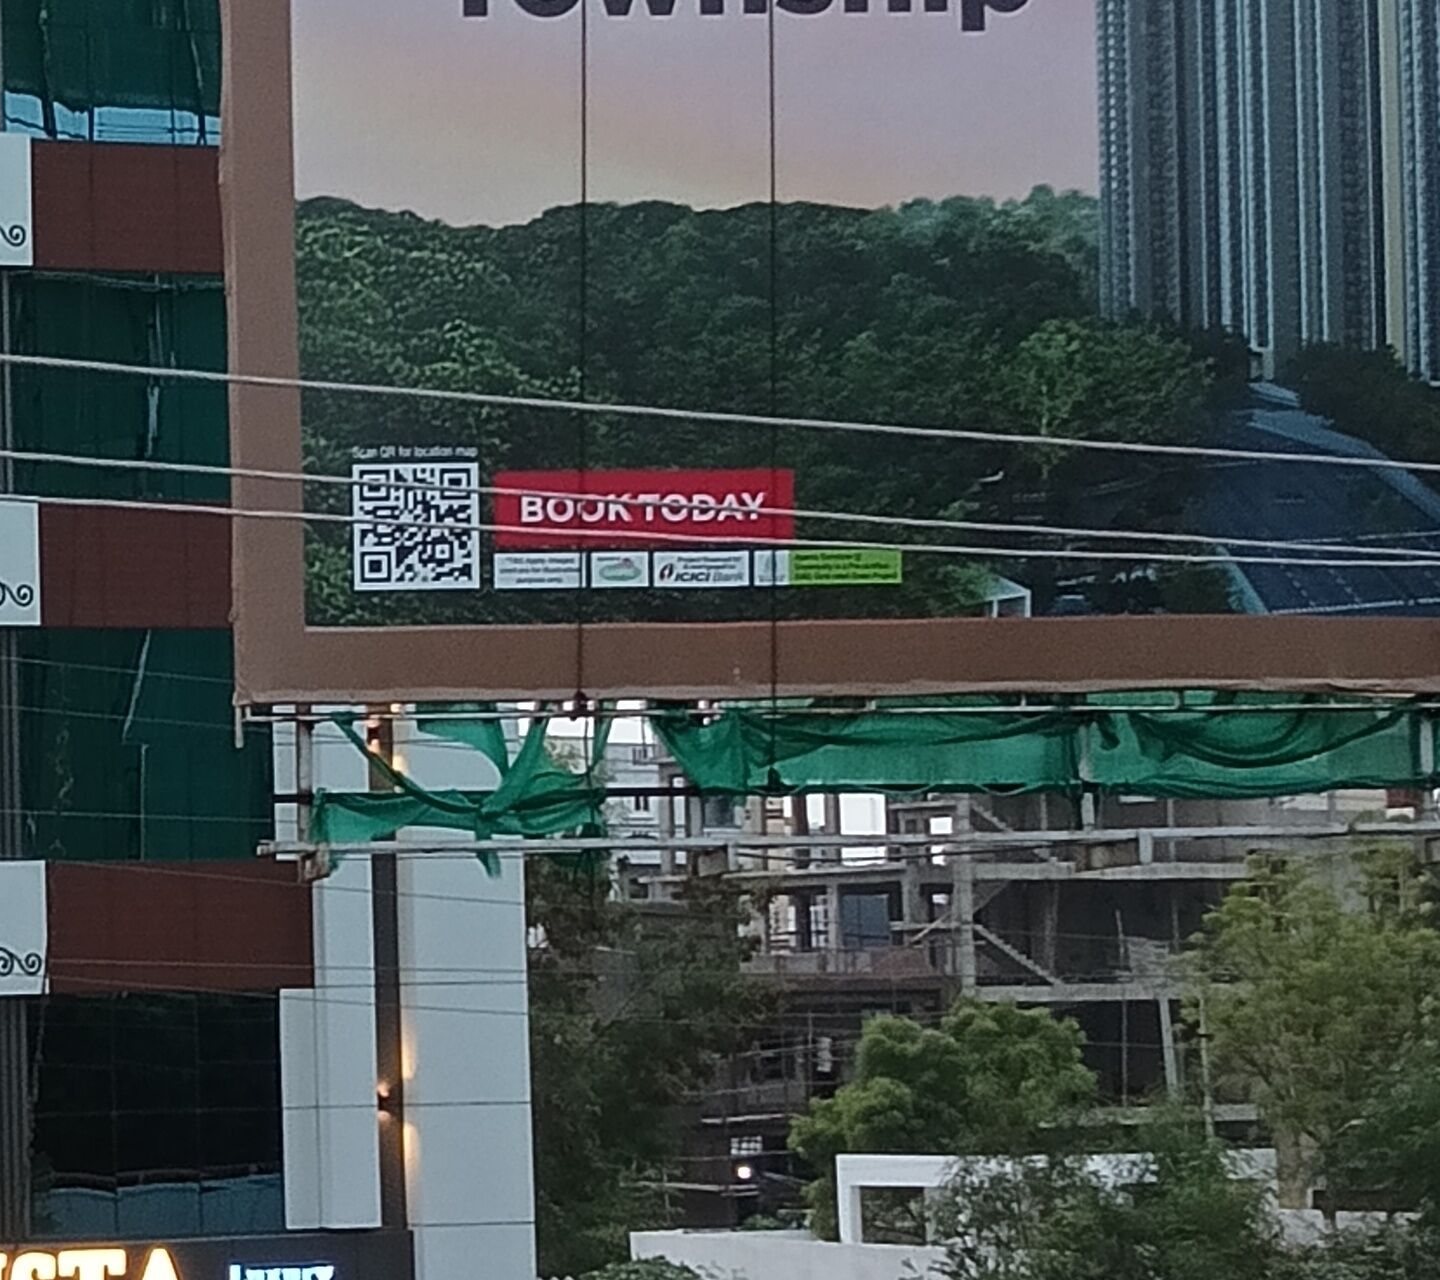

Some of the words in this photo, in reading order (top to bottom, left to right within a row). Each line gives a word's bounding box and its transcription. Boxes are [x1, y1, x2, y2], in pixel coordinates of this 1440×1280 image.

[521, 486, 631, 523] BOOK
[634, 493, 764, 521] TODAY
[674, 571, 711, 582] ICICI
